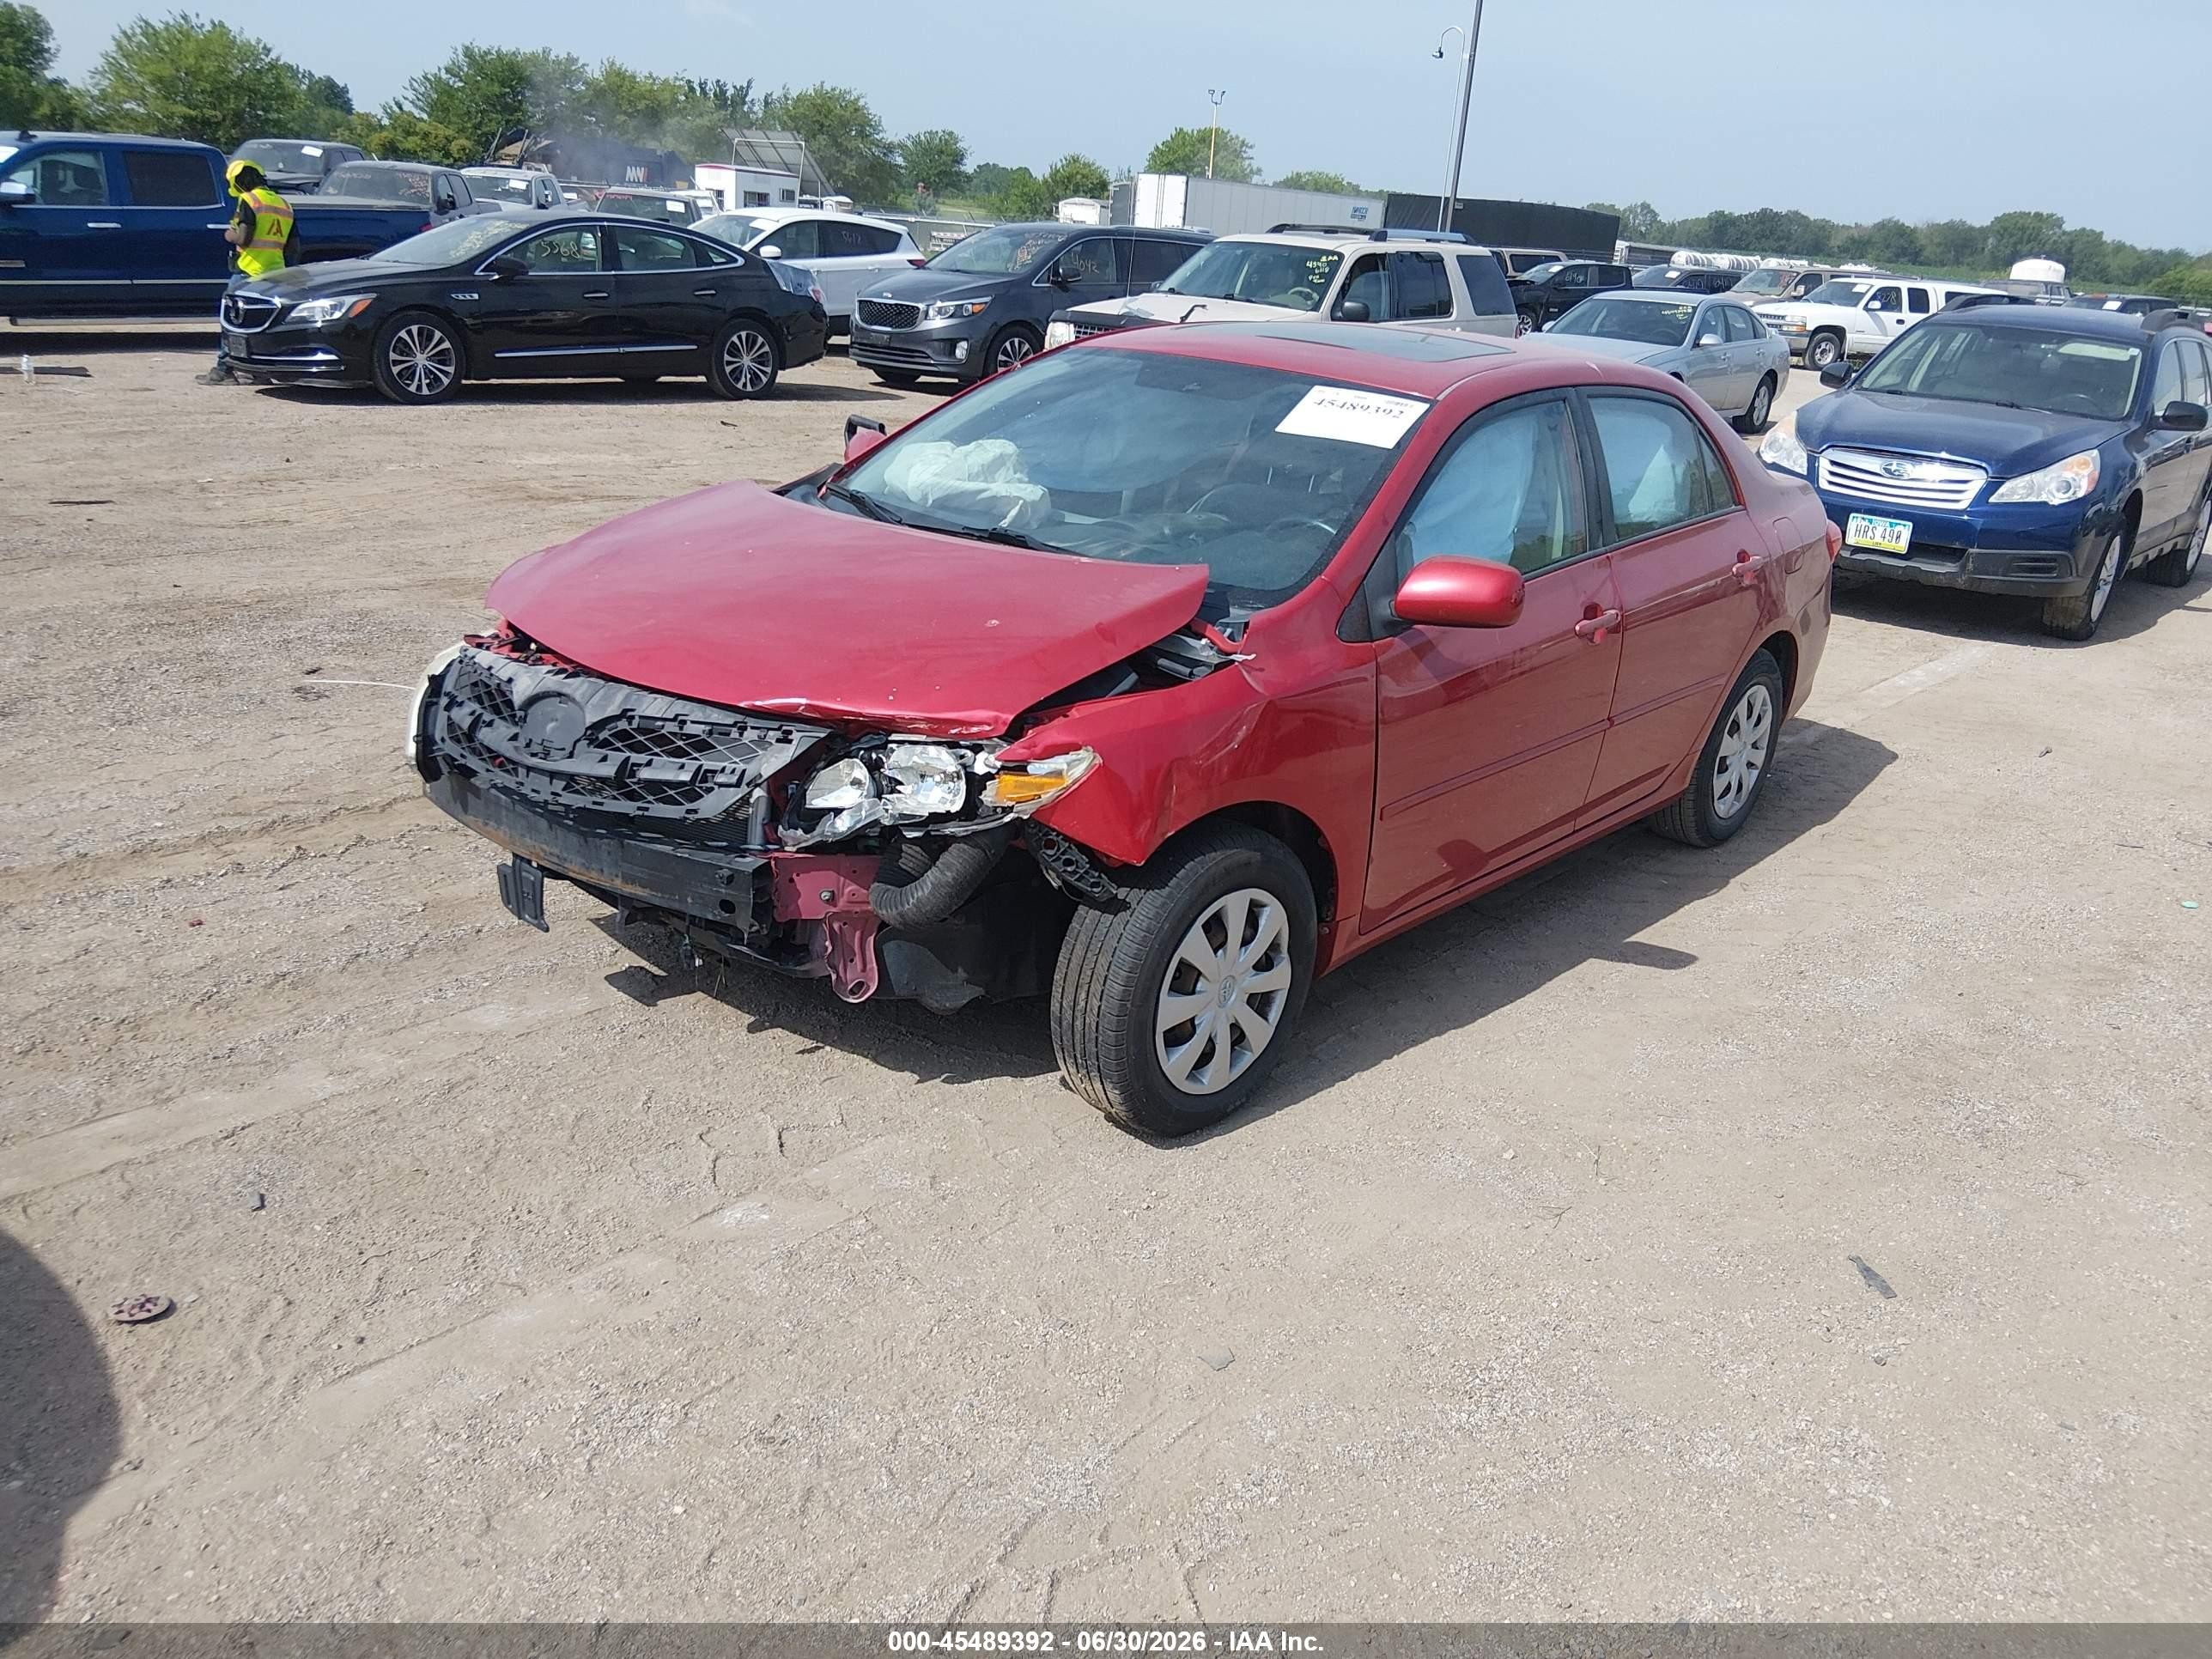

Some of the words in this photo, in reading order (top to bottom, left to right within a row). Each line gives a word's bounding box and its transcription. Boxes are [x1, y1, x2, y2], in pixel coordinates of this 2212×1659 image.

[1071, 251, 1100, 275] 4042
[1313, 397, 1406, 419] 45489392
[1854, 523, 1877, 541] HRS
[1880, 527, 1903, 544] 490
